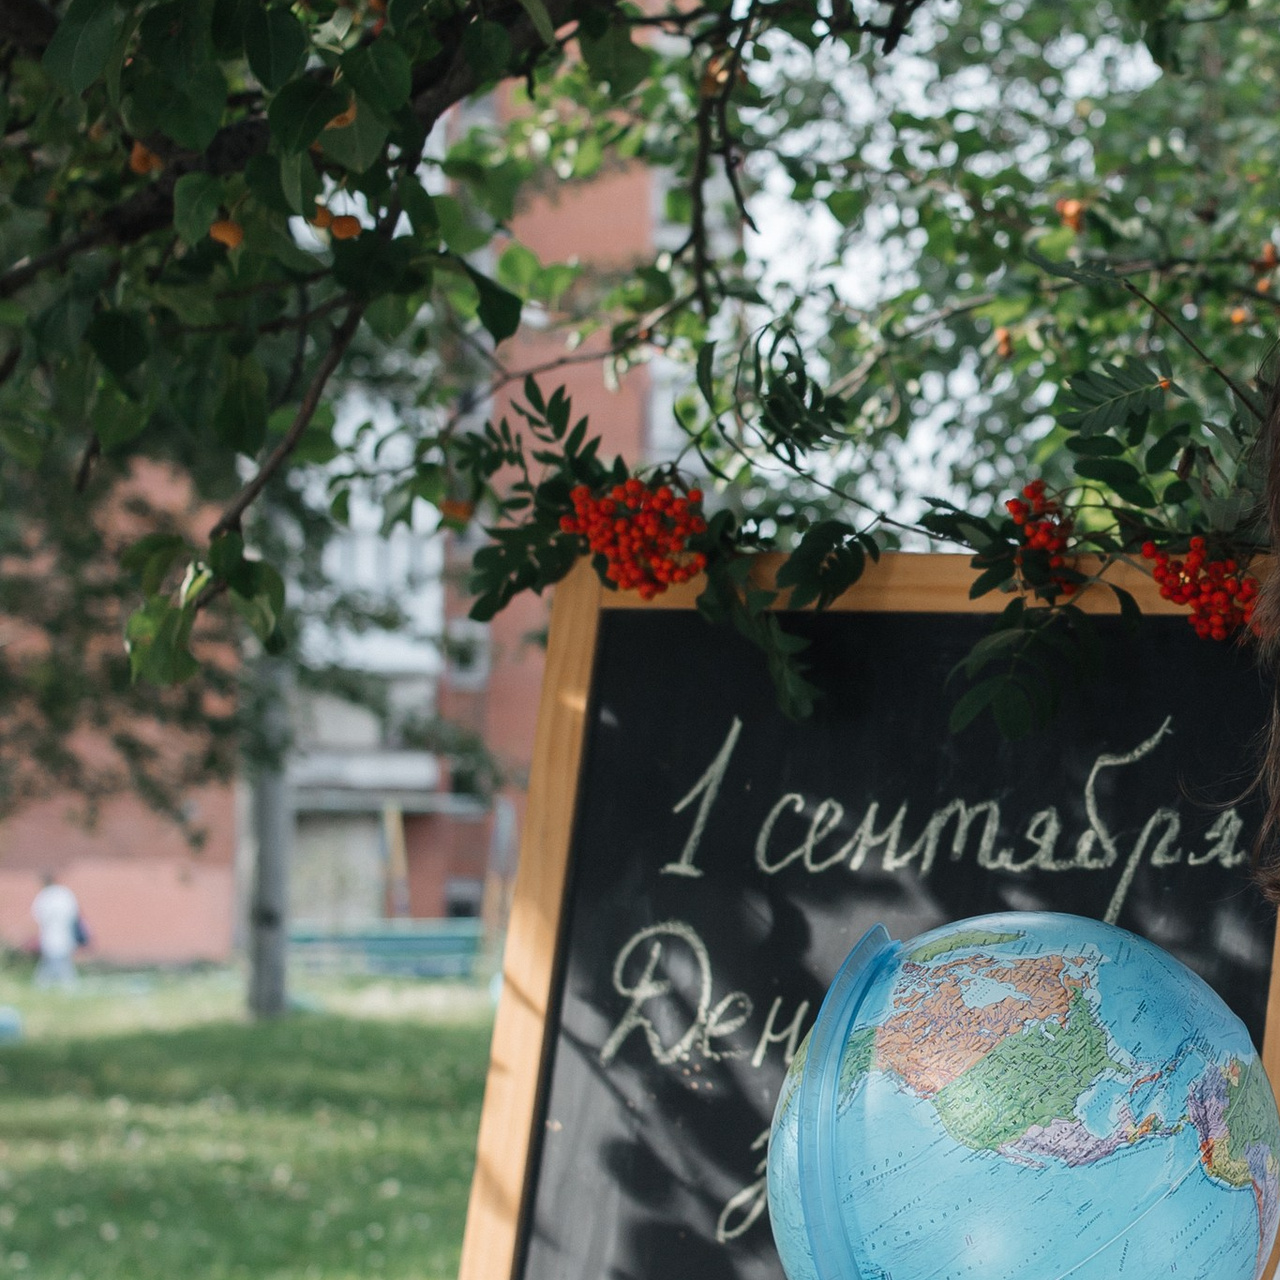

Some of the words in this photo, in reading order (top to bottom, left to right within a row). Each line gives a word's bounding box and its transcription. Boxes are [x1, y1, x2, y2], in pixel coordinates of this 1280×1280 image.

[659, 716, 743, 877] 1
[755, 715, 1247, 925] сентября
[599, 920, 810, 1067] Ден
